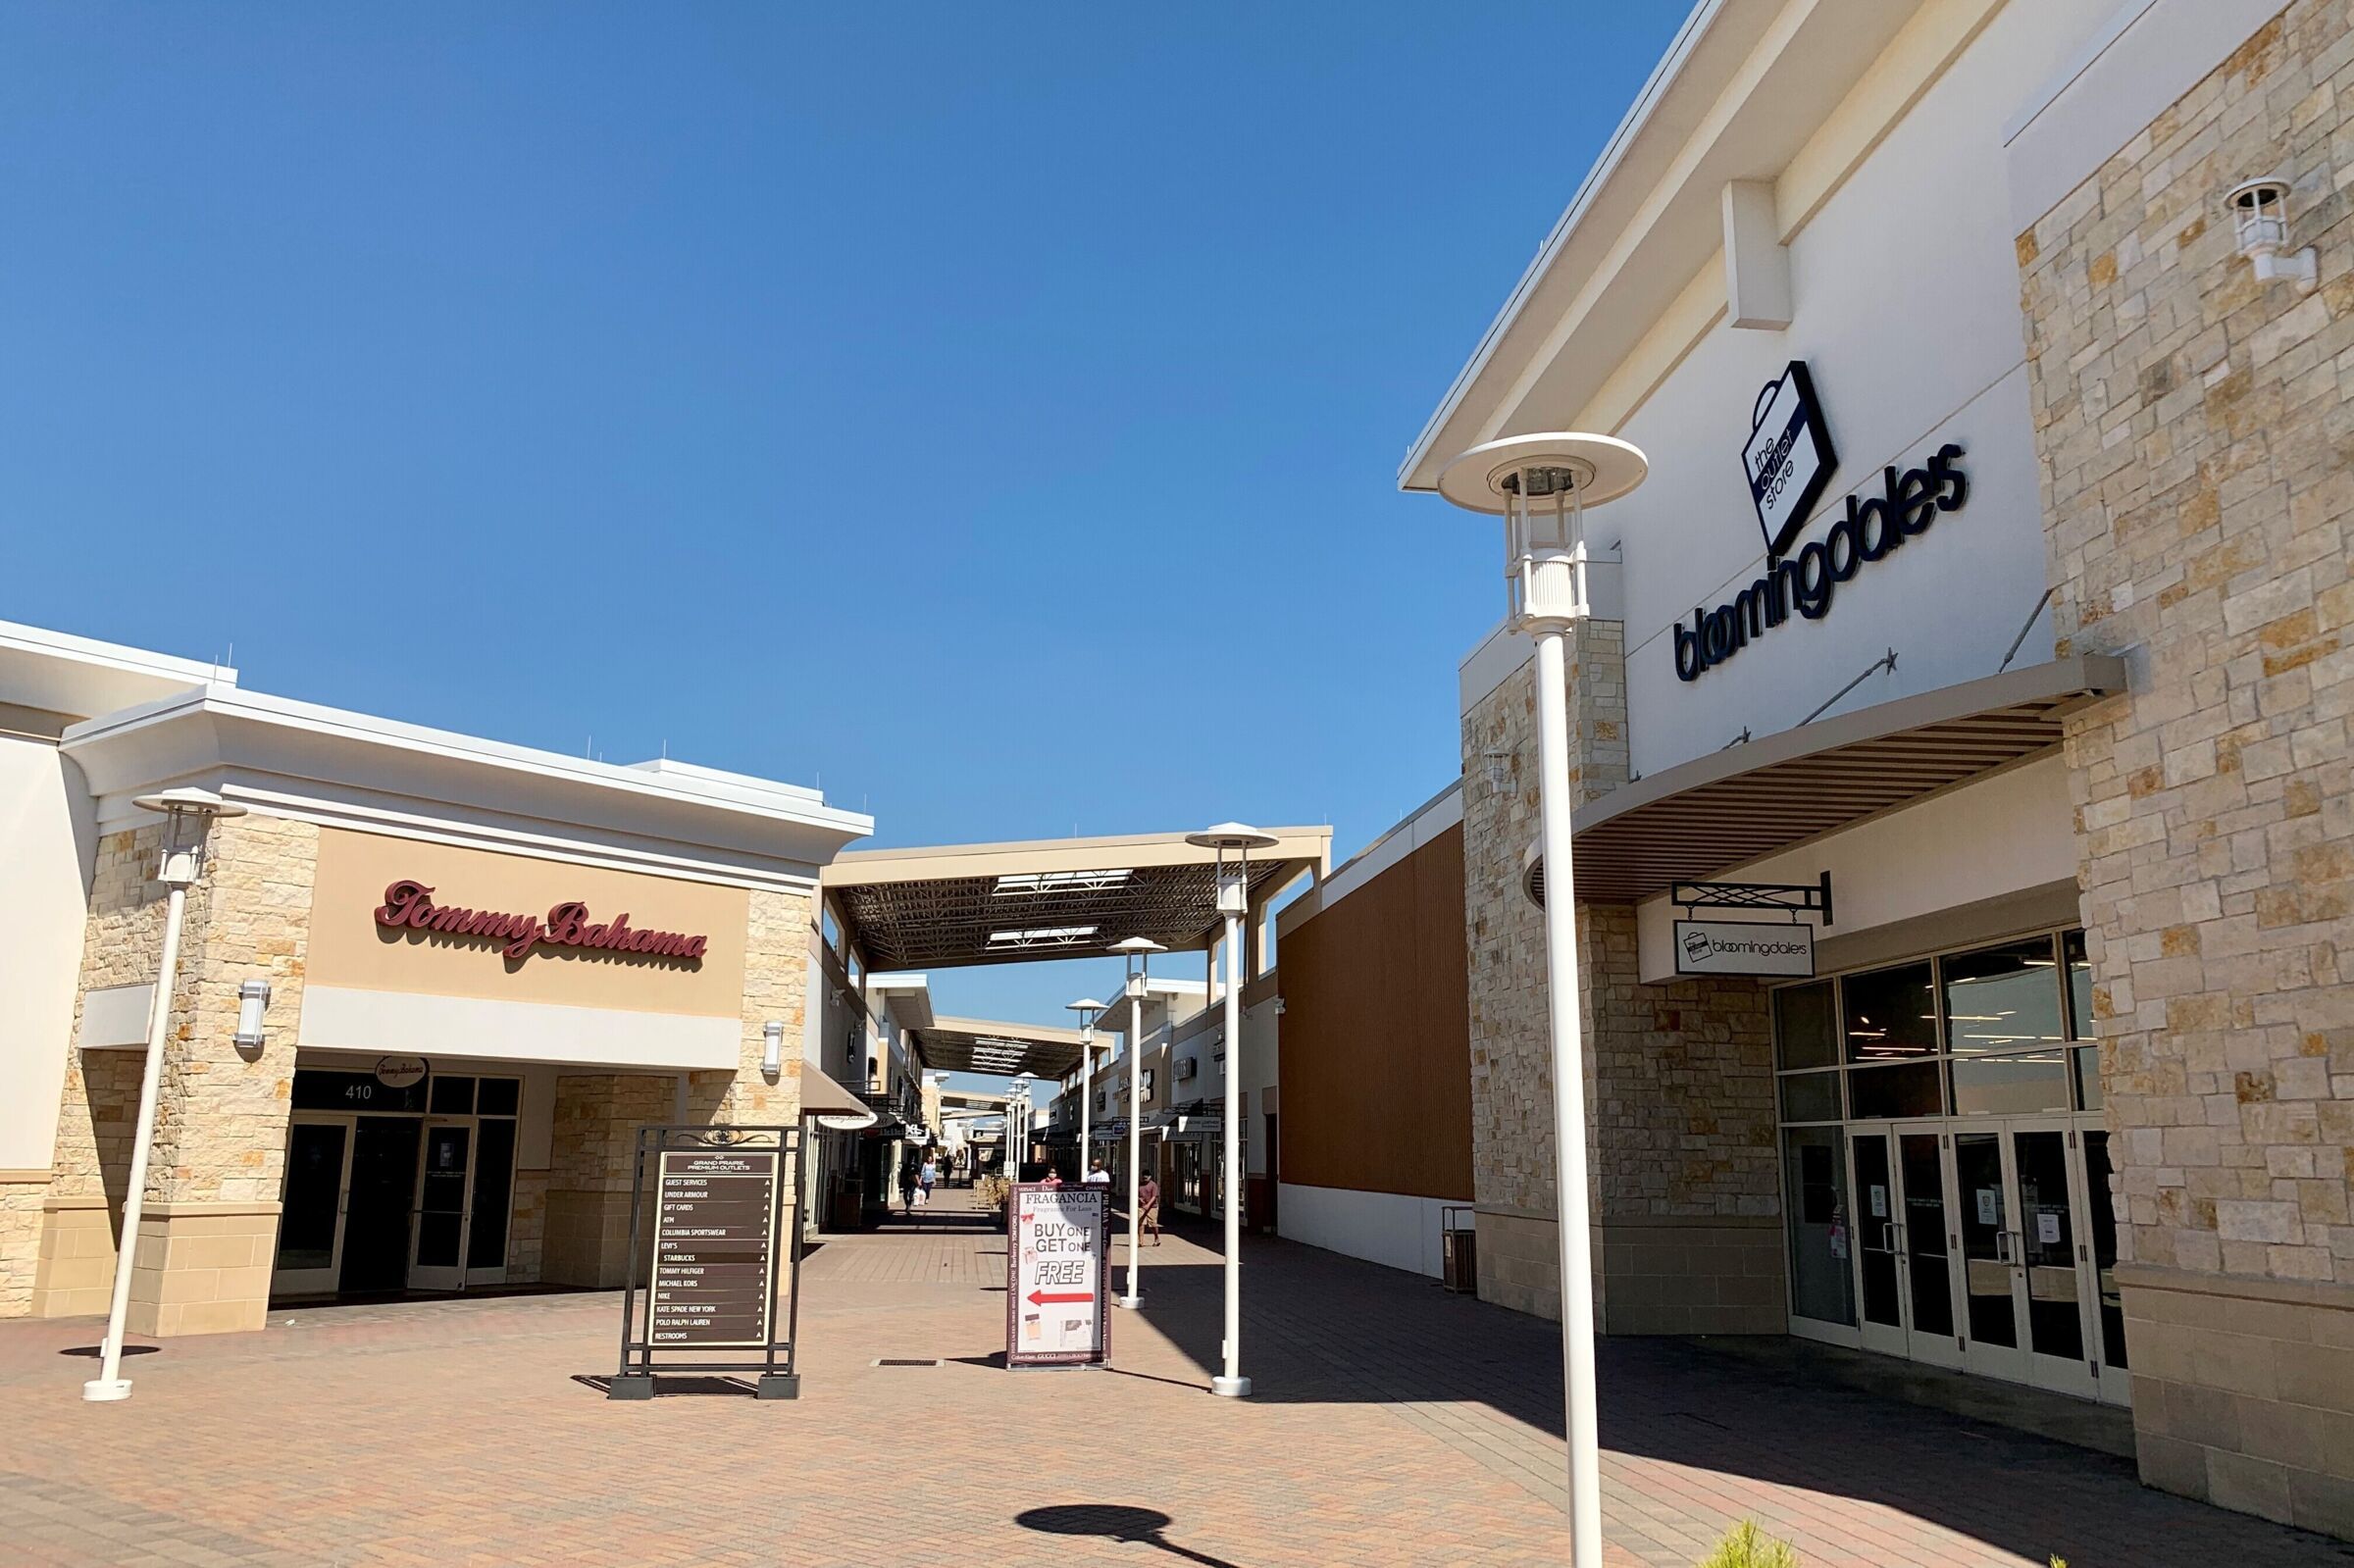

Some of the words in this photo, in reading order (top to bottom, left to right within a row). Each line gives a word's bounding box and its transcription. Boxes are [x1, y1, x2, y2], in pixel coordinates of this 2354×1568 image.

[1754, 436, 1775, 473] the
[1761, 430, 1793, 490] outlet
[1766, 459, 1794, 510] store
[374, 879, 540, 959] Tommy
[540, 900, 708, 958] Bahama
[345, 1085, 372, 1099] 410
[1026, 1192, 1098, 1204] FRAGANCIA
[1035, 1223, 1065, 1238] BUY
[1067, 1226, 1090, 1237] ONE
[1036, 1239, 1067, 1252] GET
[1069, 1241, 1091, 1252] ONE
[1035, 1260, 1085, 1286] FREE
